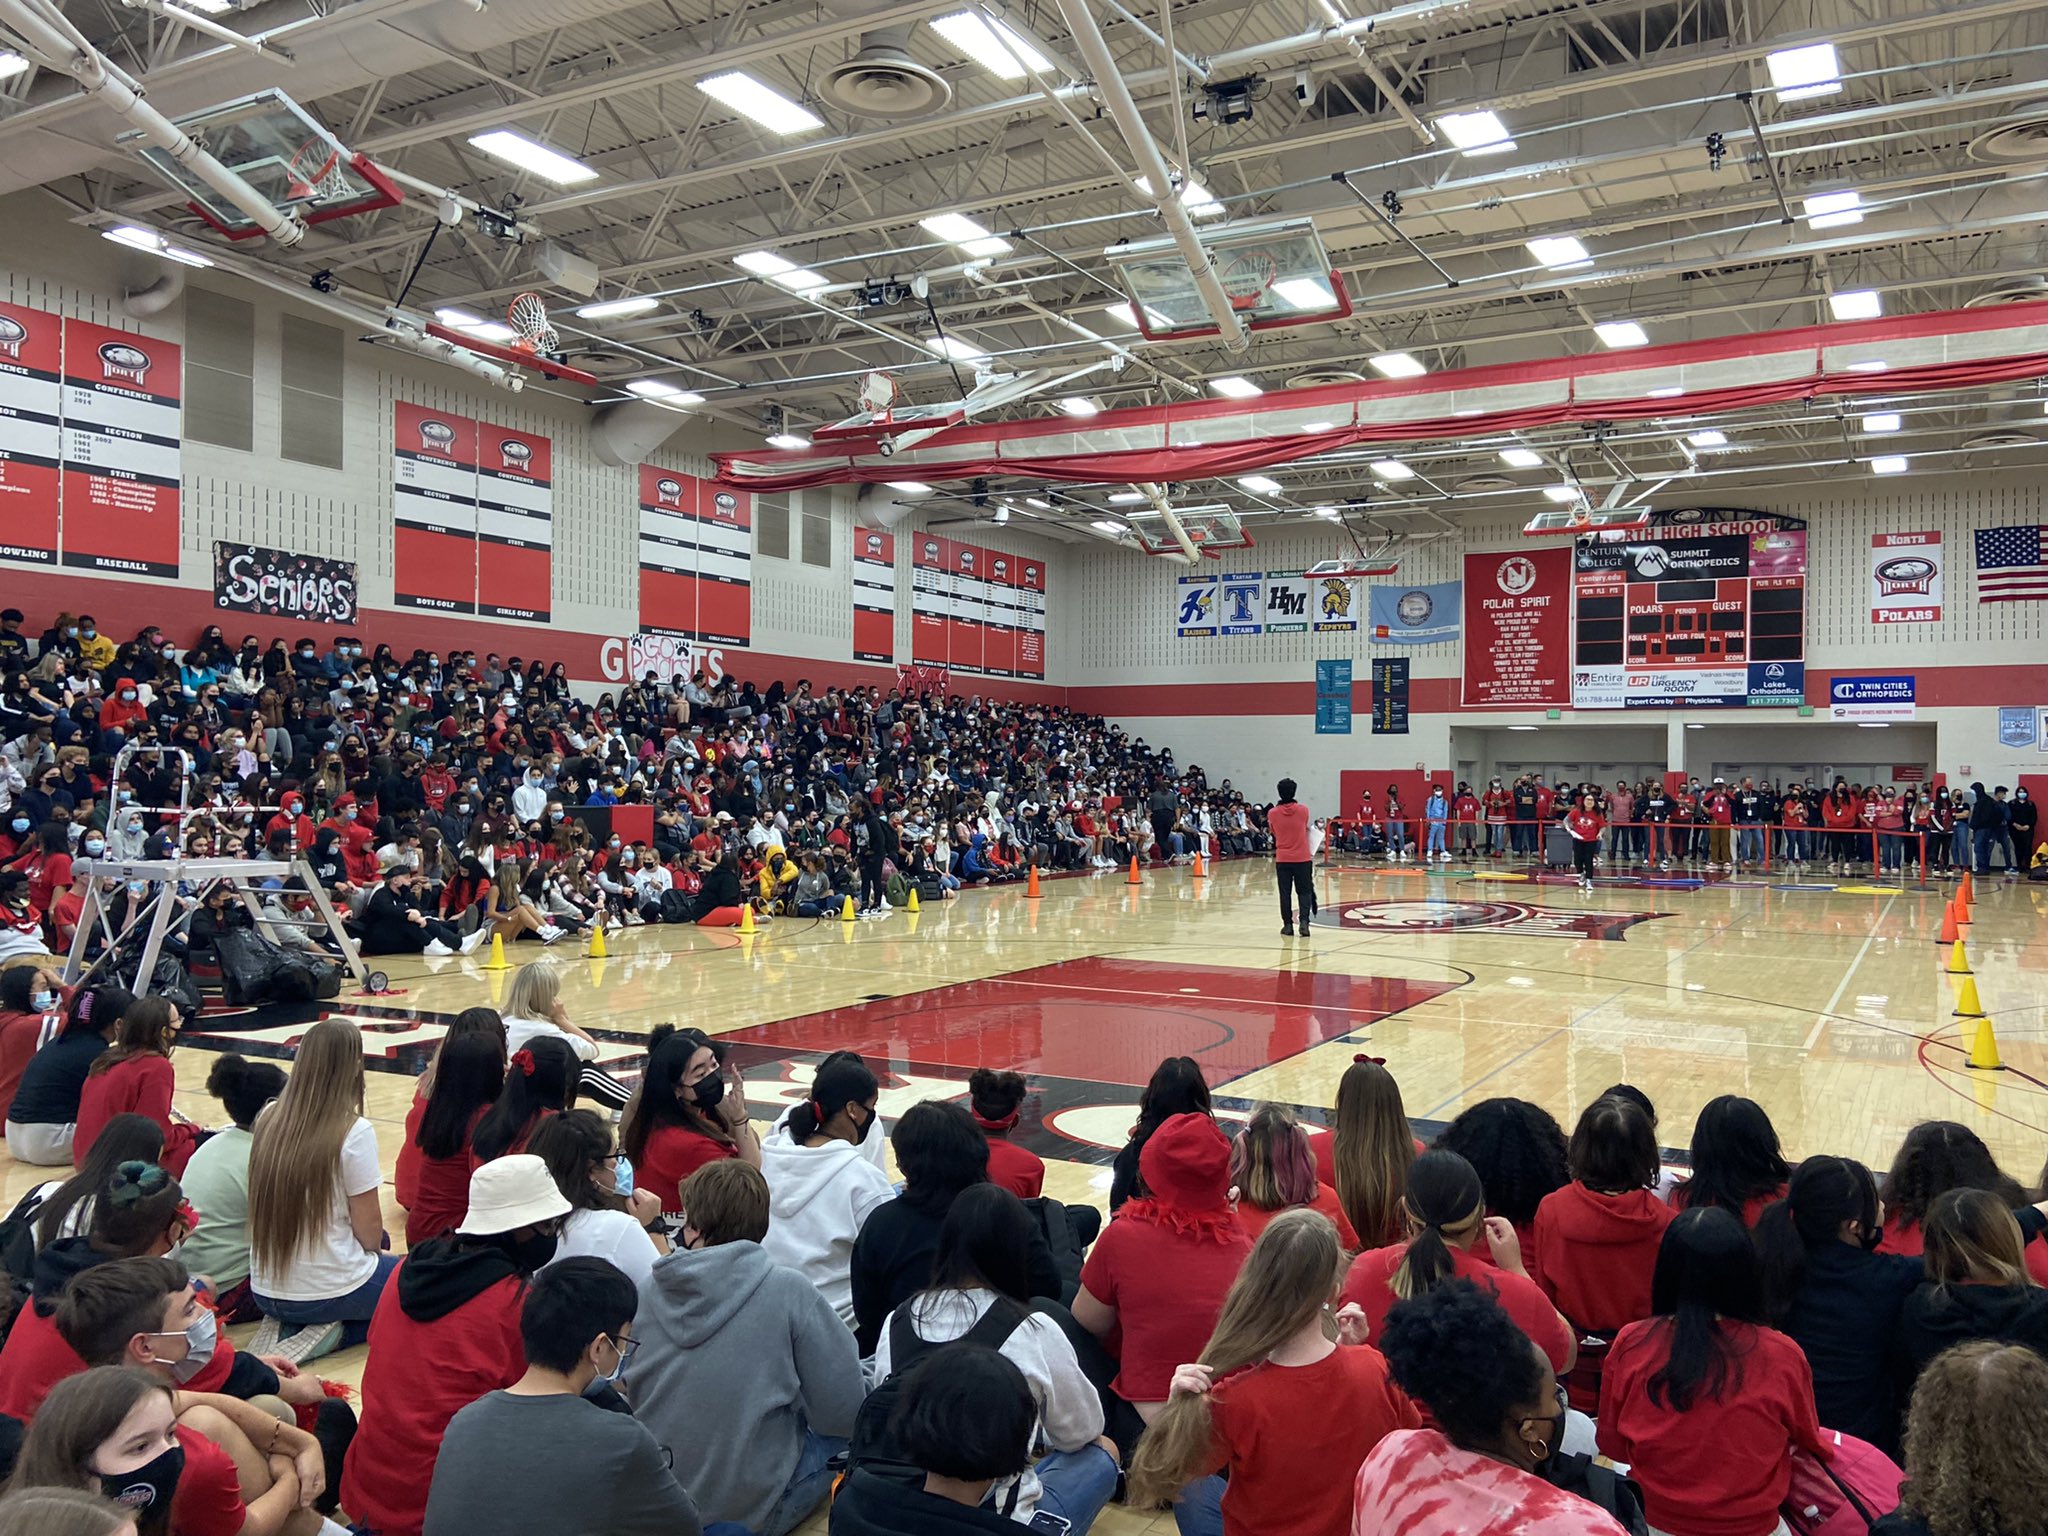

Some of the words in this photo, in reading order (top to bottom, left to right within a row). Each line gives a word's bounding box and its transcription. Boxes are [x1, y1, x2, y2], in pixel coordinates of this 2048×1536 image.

[95, 383, 153, 402] CONFERENCE
[105, 427, 143, 440] SECTION
[416, 454, 457, 468] CONFERENCE
[110, 469, 137, 480] STATE
[498, 472, 534, 484] CONFERENCE
[423, 490, 451, 500] SECTION
[504, 506, 528, 515] SECTION
[427, 524, 447, 534] STATE
[1600, 528, 1655, 543] RTH
[1662, 524, 1702, 540] HIGH
[1708, 518, 1777, 536] SCHOOL
[1886, 534, 1926, 546] NORTH
[1577, 546, 1624, 557] CENTURY
[1670, 549, 1711, 559] SUMMIT
[96, 558, 149, 572] BASEBALL
[1578, 558, 1622, 568] COLLEGE
[1670, 558, 1740, 569] ORTHOPEDICS
[1579, 573, 1622, 583] century.edu
[1882, 579, 1929, 594] NORTH
[416, 598, 435, 606] BOYS
[436, 600, 456, 608] GOLF
[1224, 584, 1260, 622] T
[1268, 586, 1307, 615] HM
[1482, 598, 1514, 609] POLAR
[1520, 596, 1551, 608] SPIRIT
[1630, 605, 1663, 614] POLARS
[1712, 601, 1742, 611] GUEST
[496, 608, 516, 616] GIRLS
[517, 610, 534, 618] GOLF
[1878, 610, 1934, 622] POLARS
[1228, 626, 1254, 634] TITANS
[643, 636, 675, 659] GO
[1591, 673, 1623, 682] Entira
[1629, 677, 1649, 686] UR
[1651, 679, 1698, 687] URGENCY
[1855, 690, 1912, 698] ORTHOPEDICS
[1627, 698, 1649, 706] Expert
[1685, 697, 1724, 705] Physicians.
